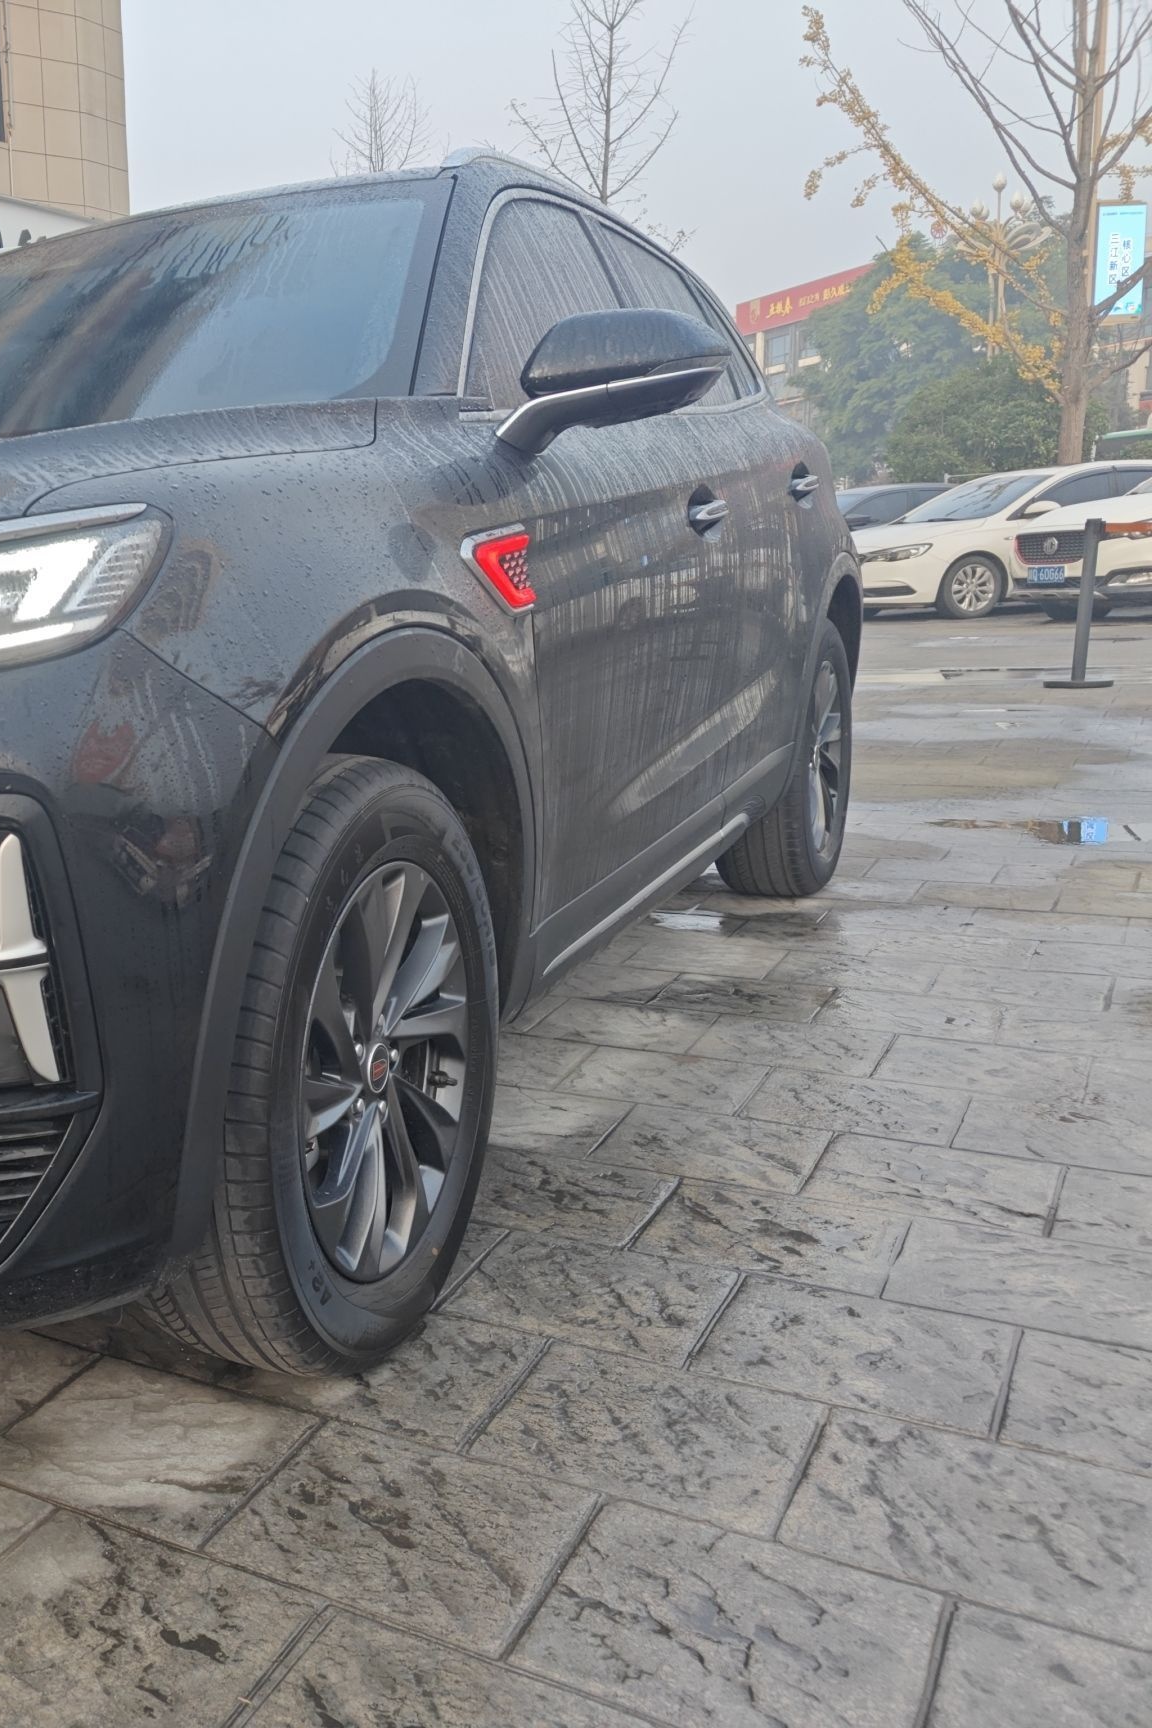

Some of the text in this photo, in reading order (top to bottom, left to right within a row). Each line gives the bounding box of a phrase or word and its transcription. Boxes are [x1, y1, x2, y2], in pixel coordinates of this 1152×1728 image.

[1108, 233, 1120, 285] 三江新区
[1121, 239, 1132, 277] 核心区
